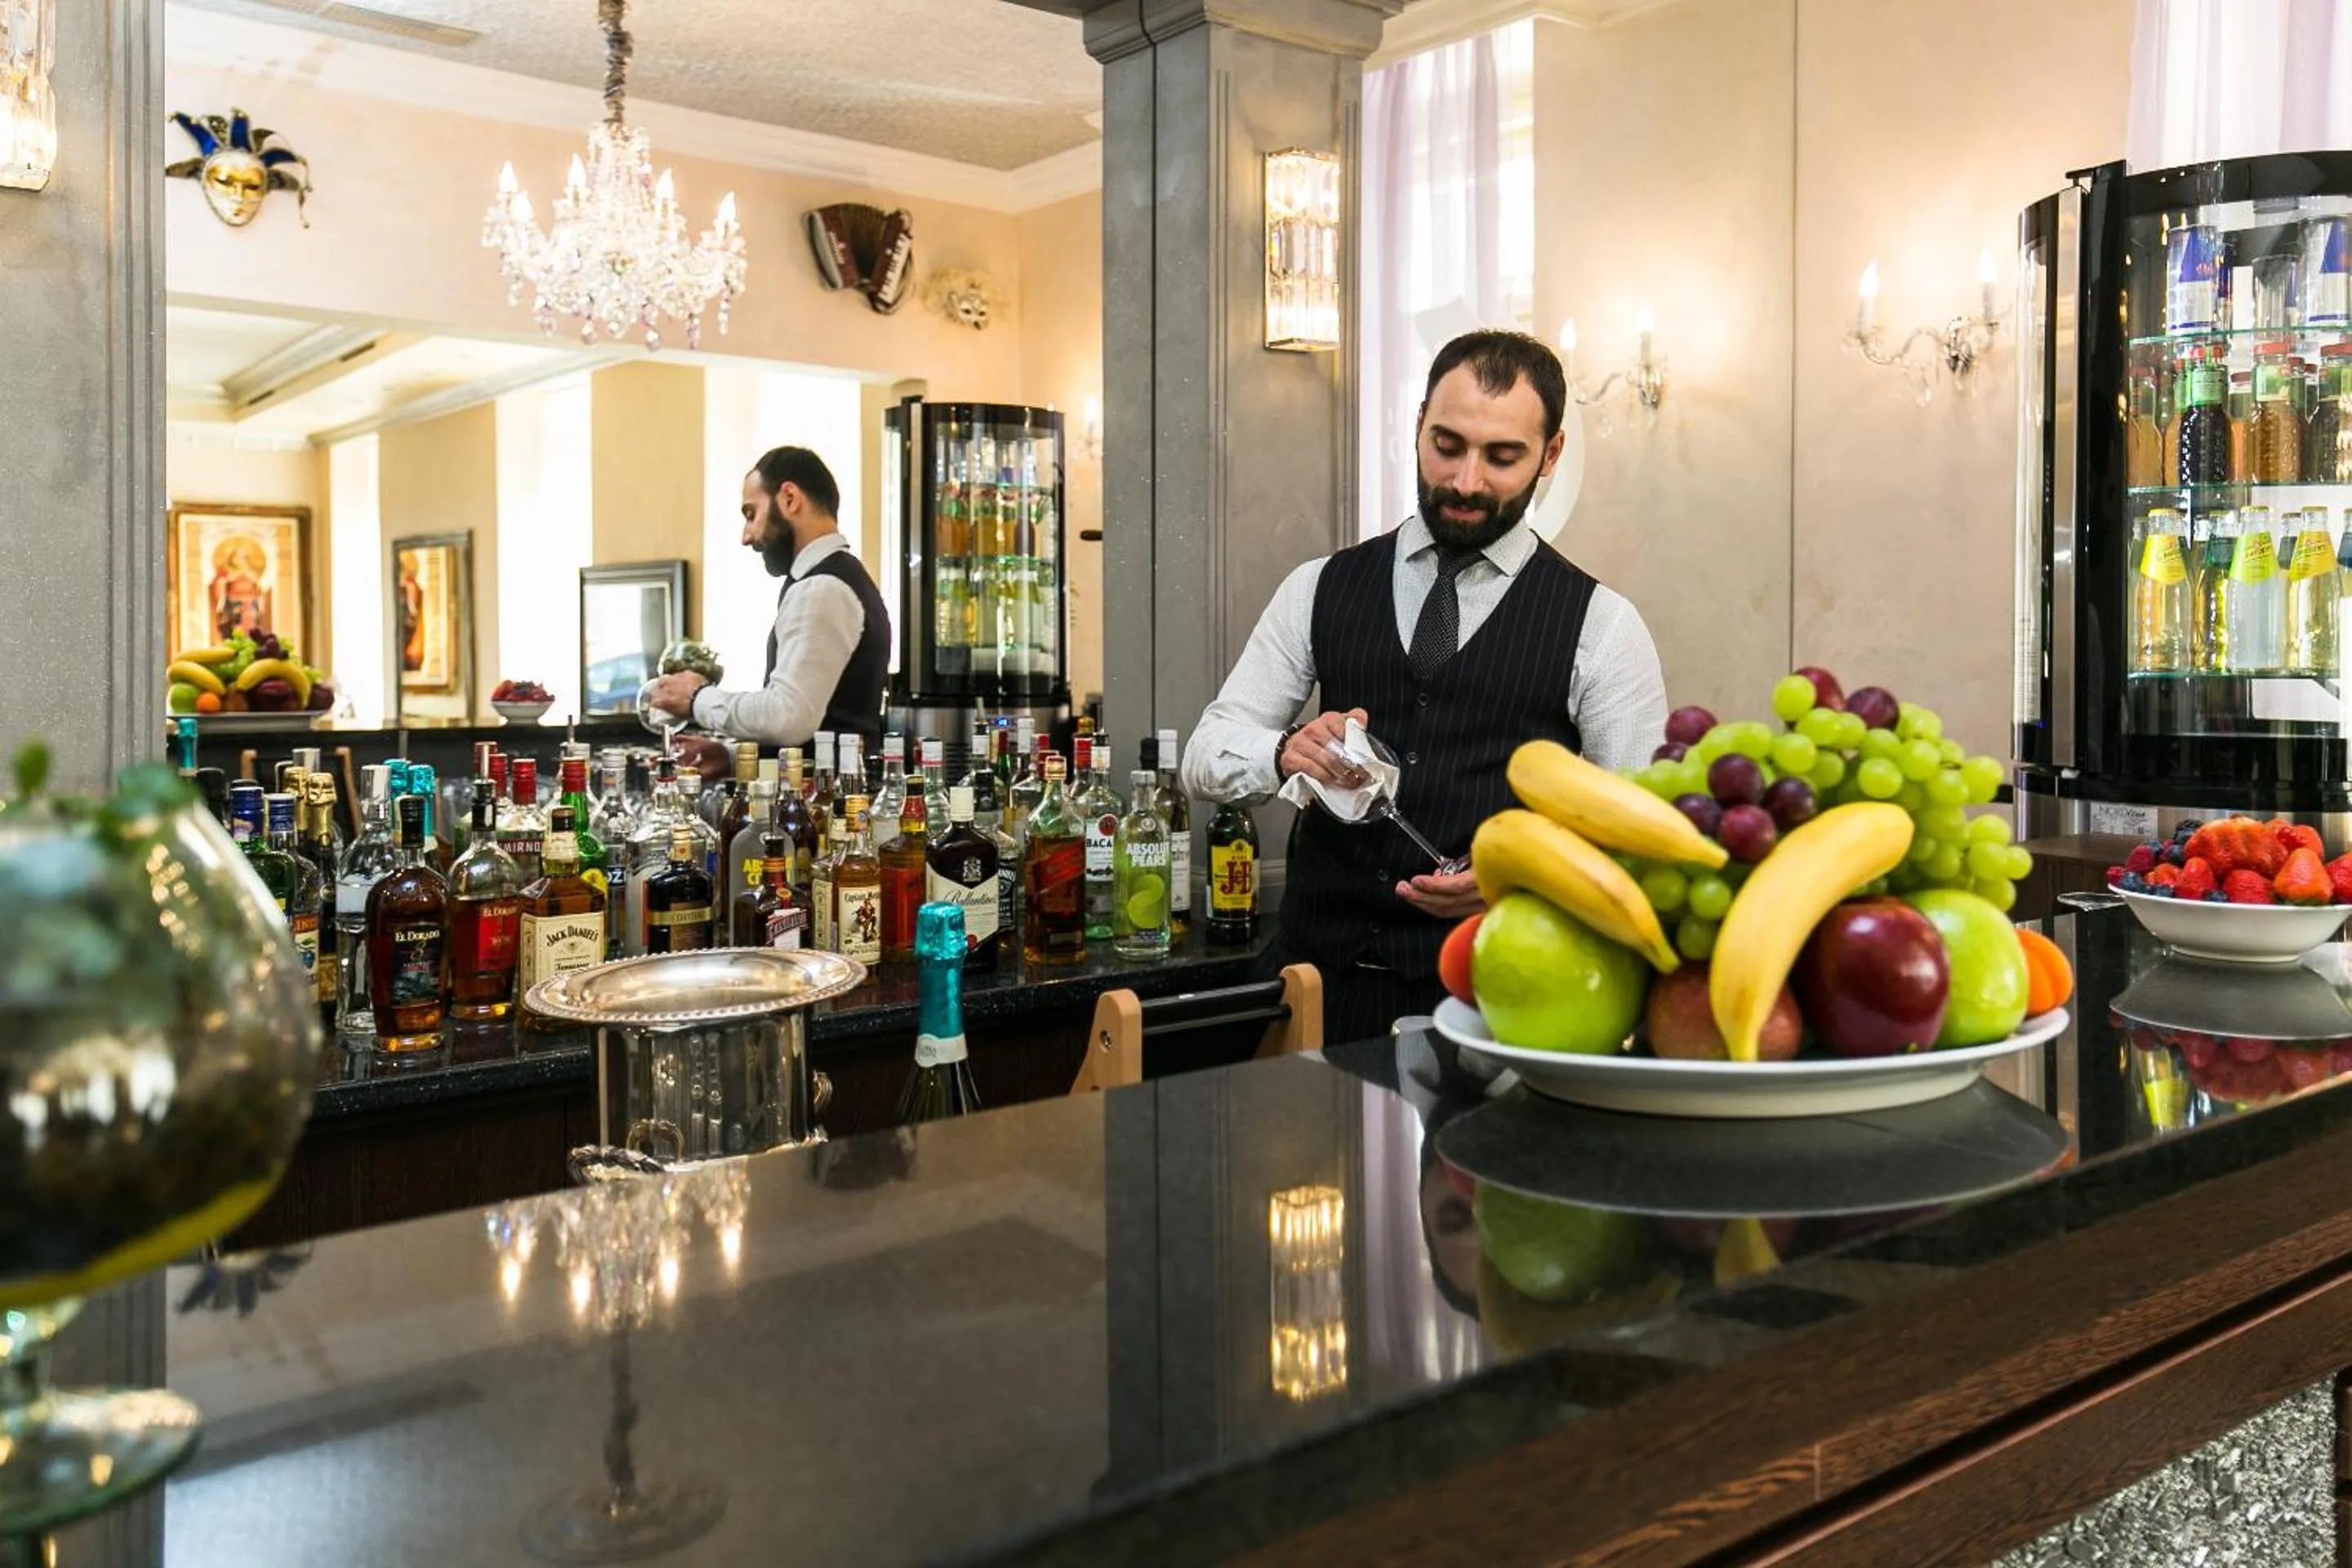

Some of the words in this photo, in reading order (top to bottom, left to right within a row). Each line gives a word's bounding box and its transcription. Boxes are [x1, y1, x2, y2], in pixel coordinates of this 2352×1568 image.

[500, 840, 541, 853] MIRNO
[1086, 839, 1112, 848] BACA
[1126, 842, 1169, 857] ABSOLUT
[1131, 854, 1166, 866] PEARS
[394, 932, 407, 942] EL
[407, 929, 440, 942] DORADO
[546, 931, 568, 947] JACK
[567, 924, 600, 942] DANIEL'S
